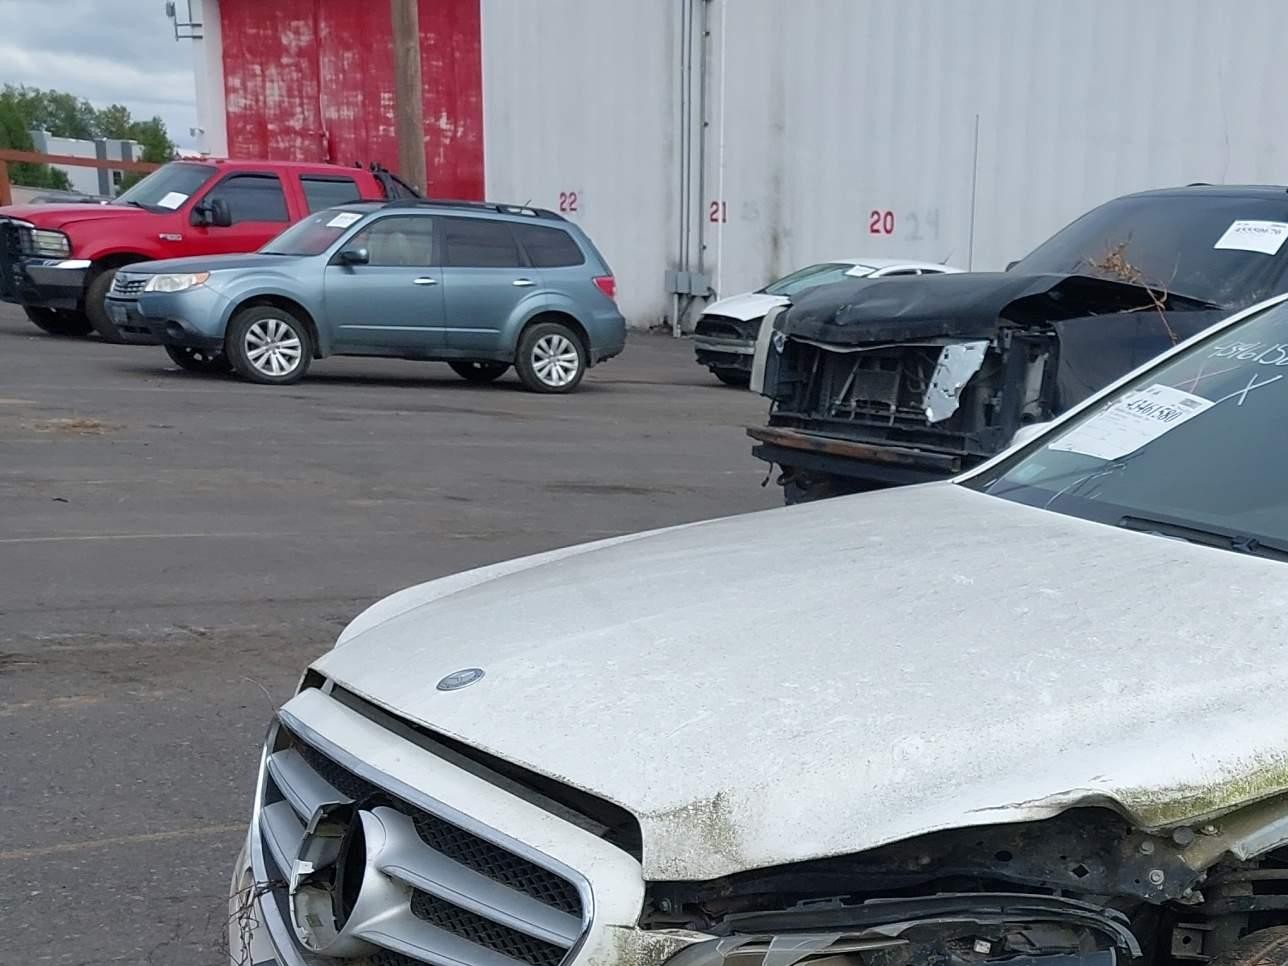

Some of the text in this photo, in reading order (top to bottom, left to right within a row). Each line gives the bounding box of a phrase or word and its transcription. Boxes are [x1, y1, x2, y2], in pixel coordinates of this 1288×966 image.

[559, 192, 578, 212] 22
[709, 201, 727, 223] 21
[869, 210, 895, 235] 20
[1127, 398, 1184, 423] 43461580
